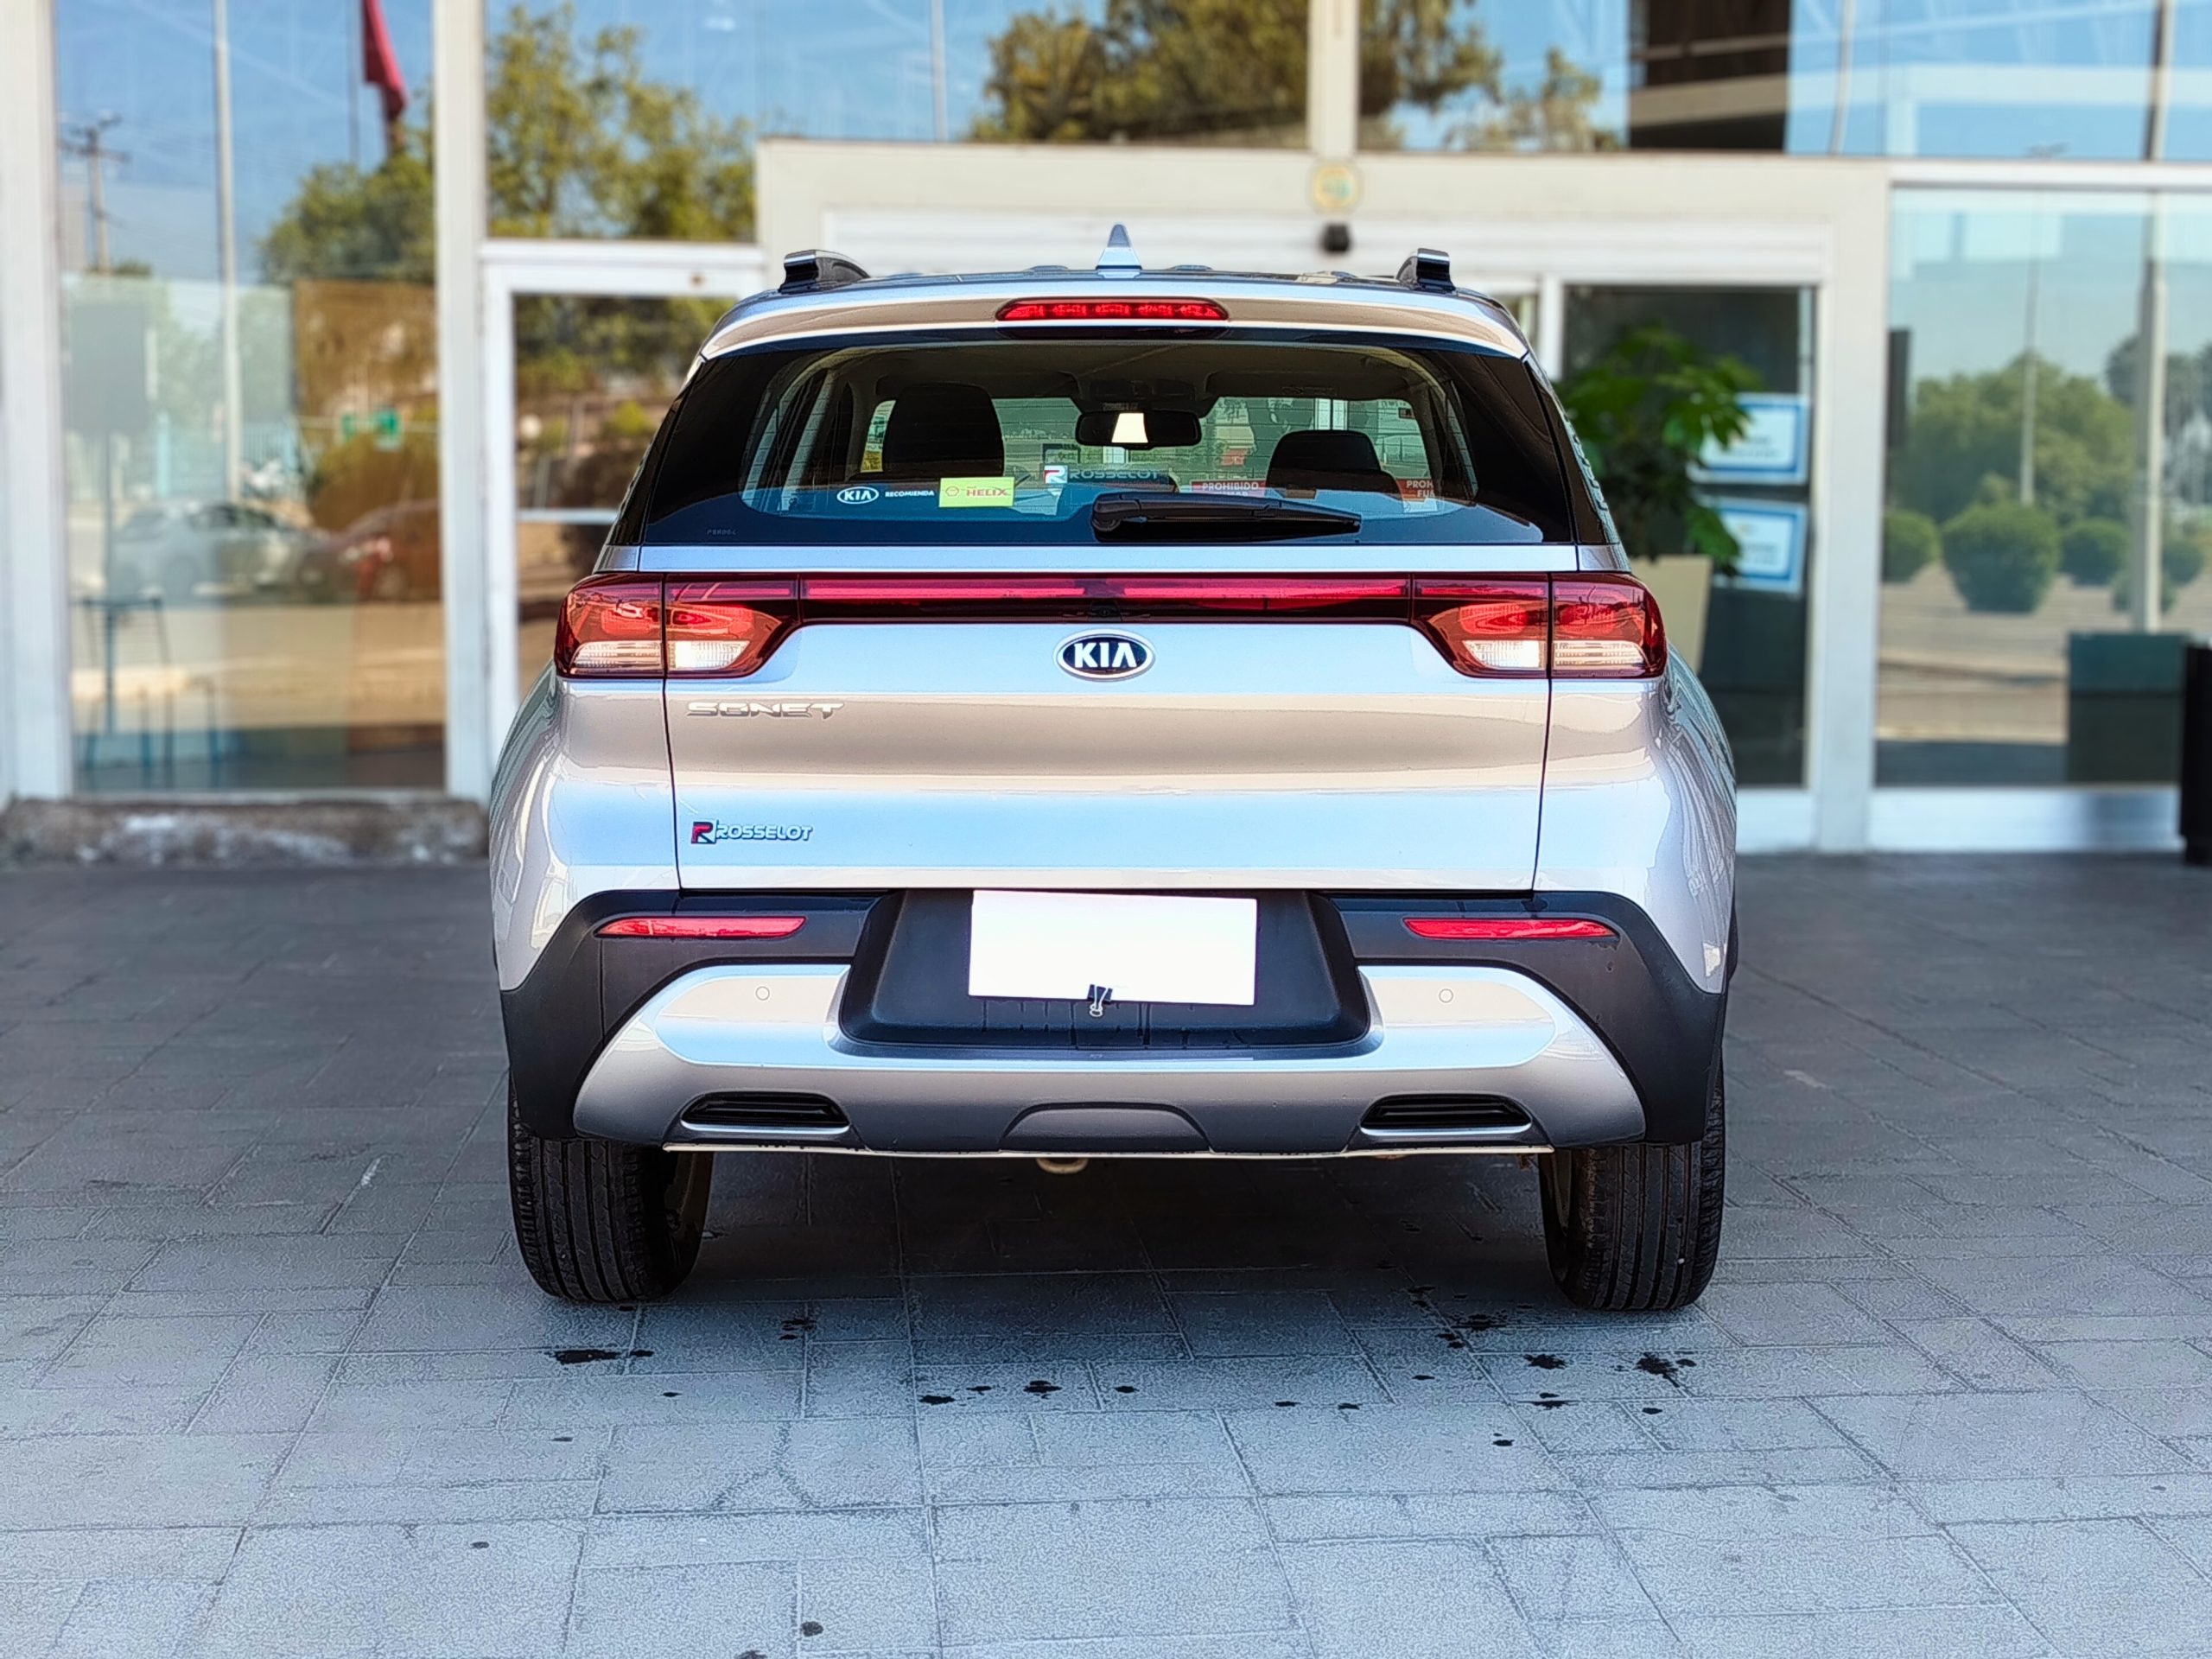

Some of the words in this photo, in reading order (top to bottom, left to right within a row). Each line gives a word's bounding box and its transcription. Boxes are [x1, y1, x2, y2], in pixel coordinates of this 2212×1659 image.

[966, 488, 1007, 497] HELIX
[1202, 481, 1260, 492] PROHIBIDO
[843, 490, 871, 501] KIA
[1074, 642, 1137, 668] KIA
[687, 702, 844, 719] SONET
[716, 824, 813, 842] ROSSELOT
